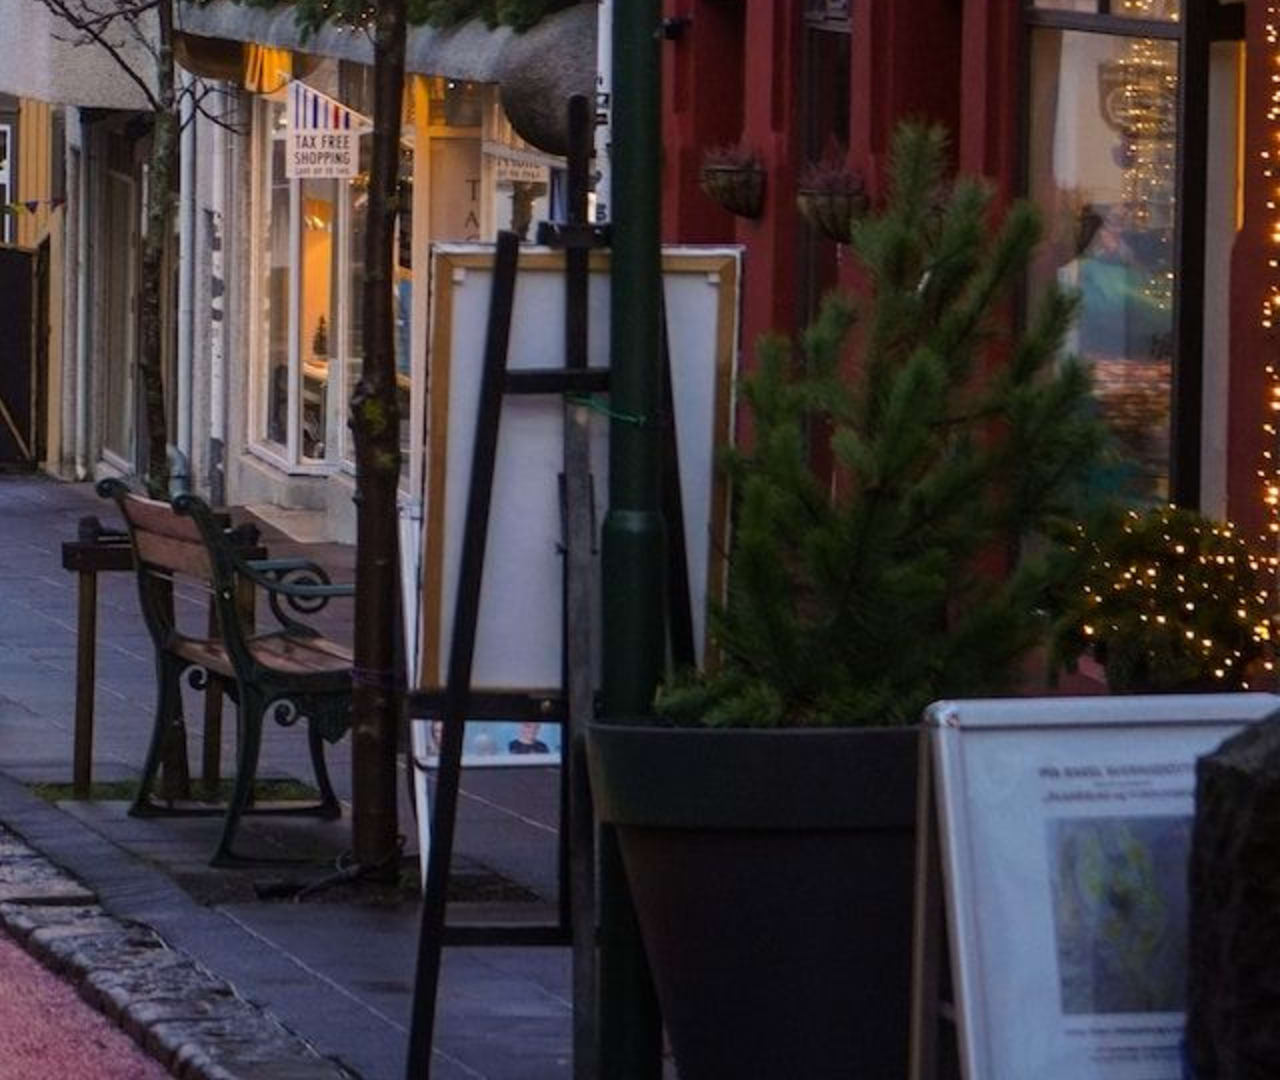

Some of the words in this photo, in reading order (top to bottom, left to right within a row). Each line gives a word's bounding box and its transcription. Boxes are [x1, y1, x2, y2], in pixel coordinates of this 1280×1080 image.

[295, 135, 317, 149] TAX
[321, 136, 350, 149] FREE
[294, 151, 351, 165] SHOPPING
